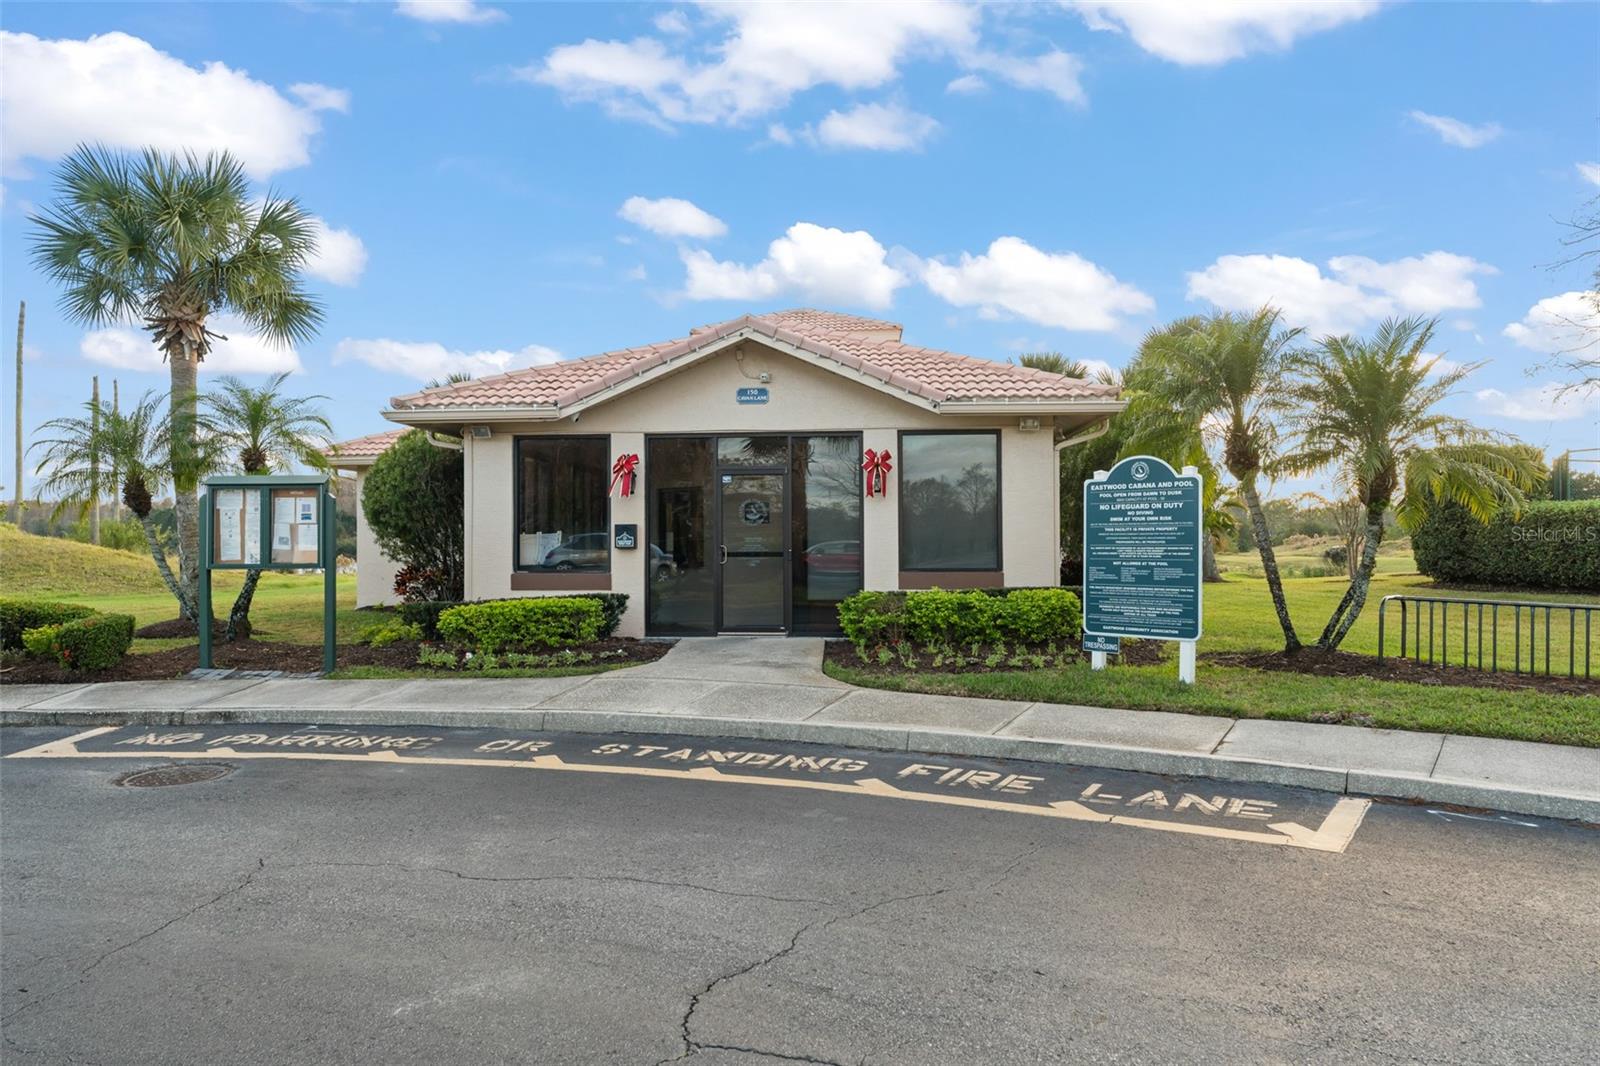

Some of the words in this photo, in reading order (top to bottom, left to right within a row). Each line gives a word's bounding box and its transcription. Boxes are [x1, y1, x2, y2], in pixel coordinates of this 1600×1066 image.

[1085, 641, 1118, 651] TRESPASSING
[113, 733, 204, 745] NO
[205, 733, 443, 749] PARKING
[473, 739, 554, 753] OR
[591, 743, 870, 773] STANDING
[897, 763, 1045, 794] FIRE
[1078, 783, 1278, 821] LANE
